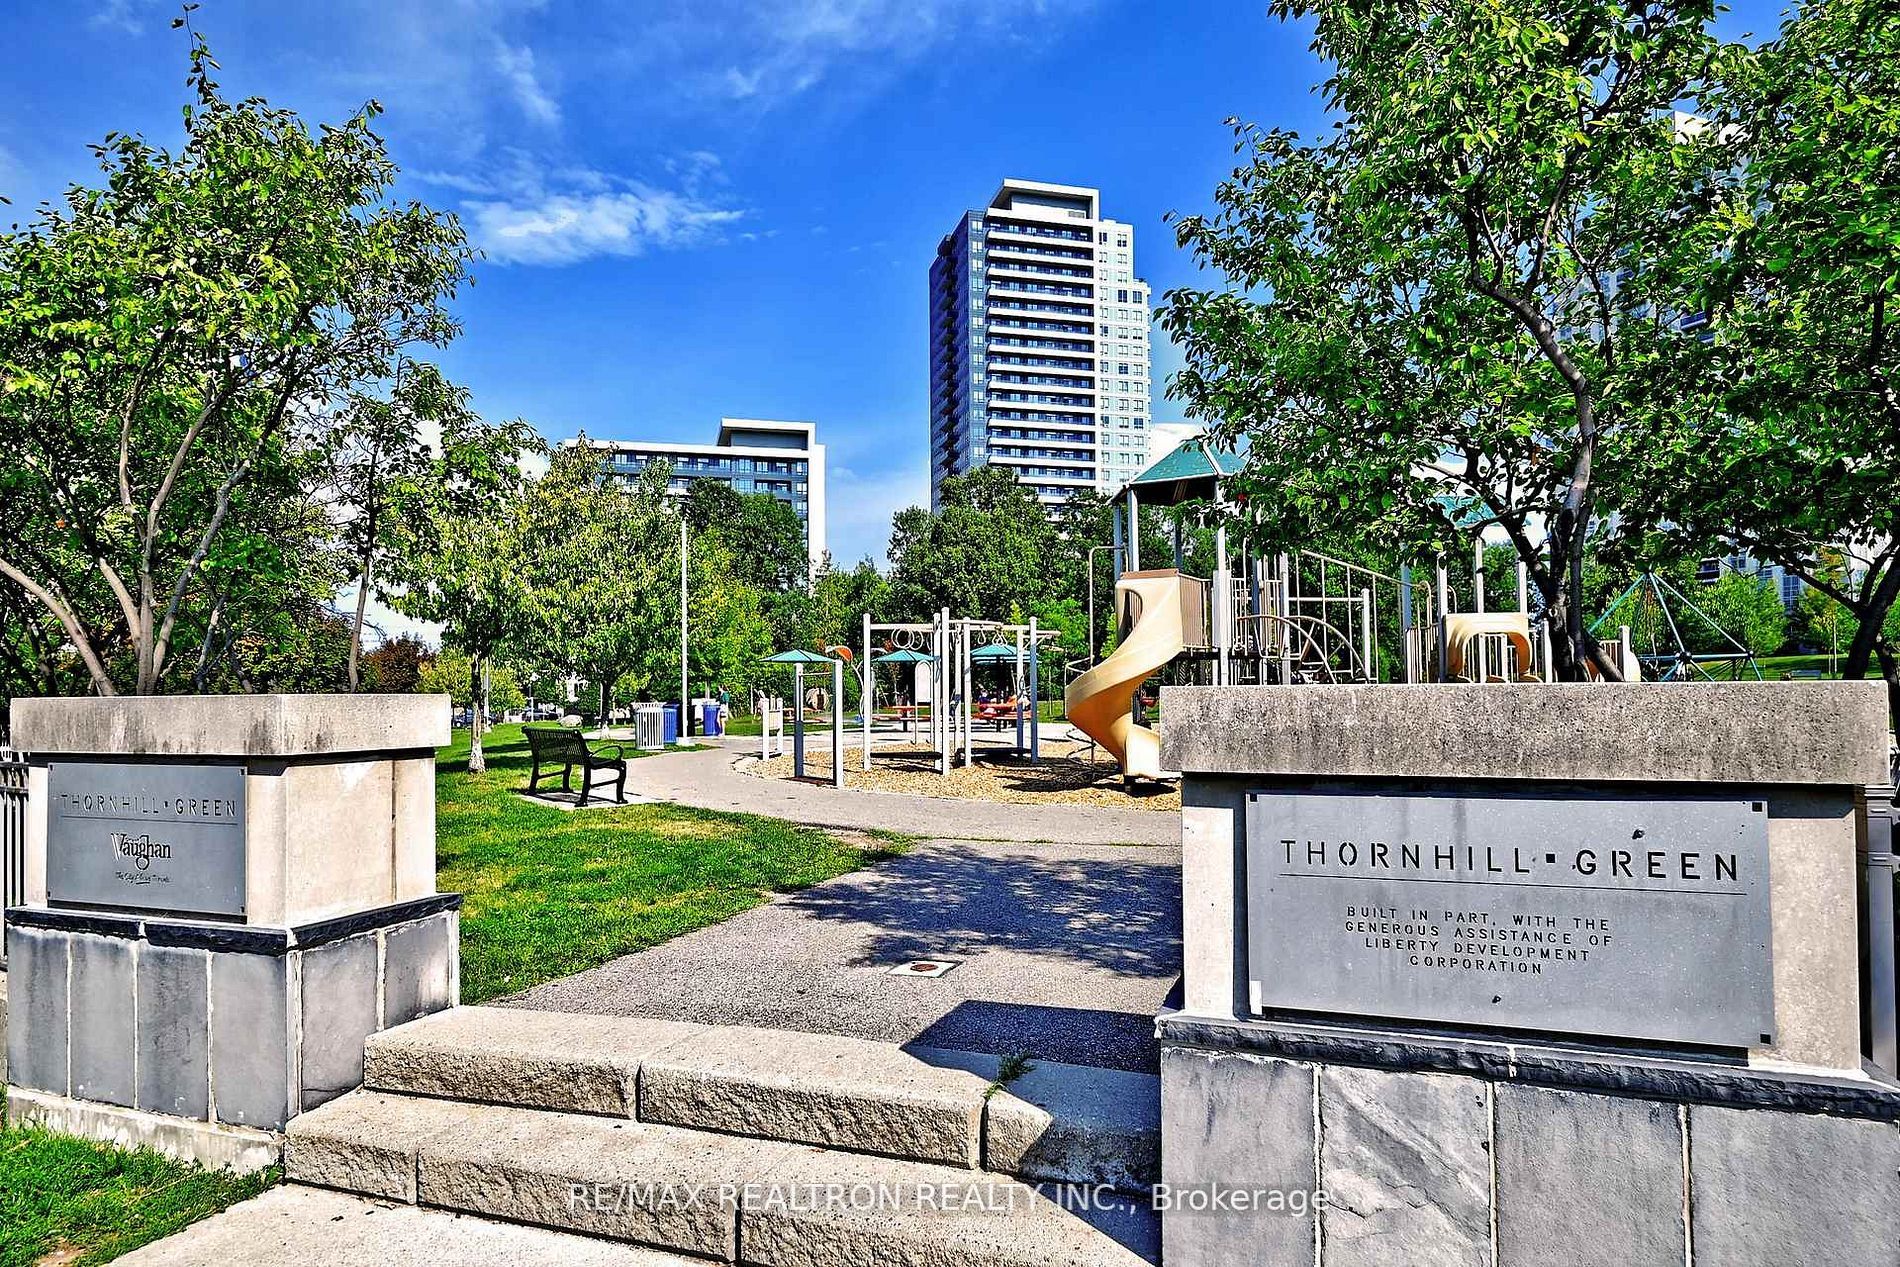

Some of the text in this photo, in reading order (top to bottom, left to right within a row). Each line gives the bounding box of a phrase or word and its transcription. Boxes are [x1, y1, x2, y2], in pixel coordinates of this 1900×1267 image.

[61, 794, 235, 817] THORNHILL GREEN
[110, 832, 172, 871] Vaughan
[1280, 840, 1738, 881] THORNHILL GREEN
[1347, 906, 1397, 919] BUILT
[1411, 909, 1428, 921] IN
[1512, 914, 1556, 928] WITH
[1573, 917, 1609, 931] THE
[1345, 921, 1612, 947] GENEROUS ASSISTANCE OF
[1365, 937, 1589, 961] LIBERTY DEVELOPMENT
[1409, 955, 1542, 975] CORPORATION
